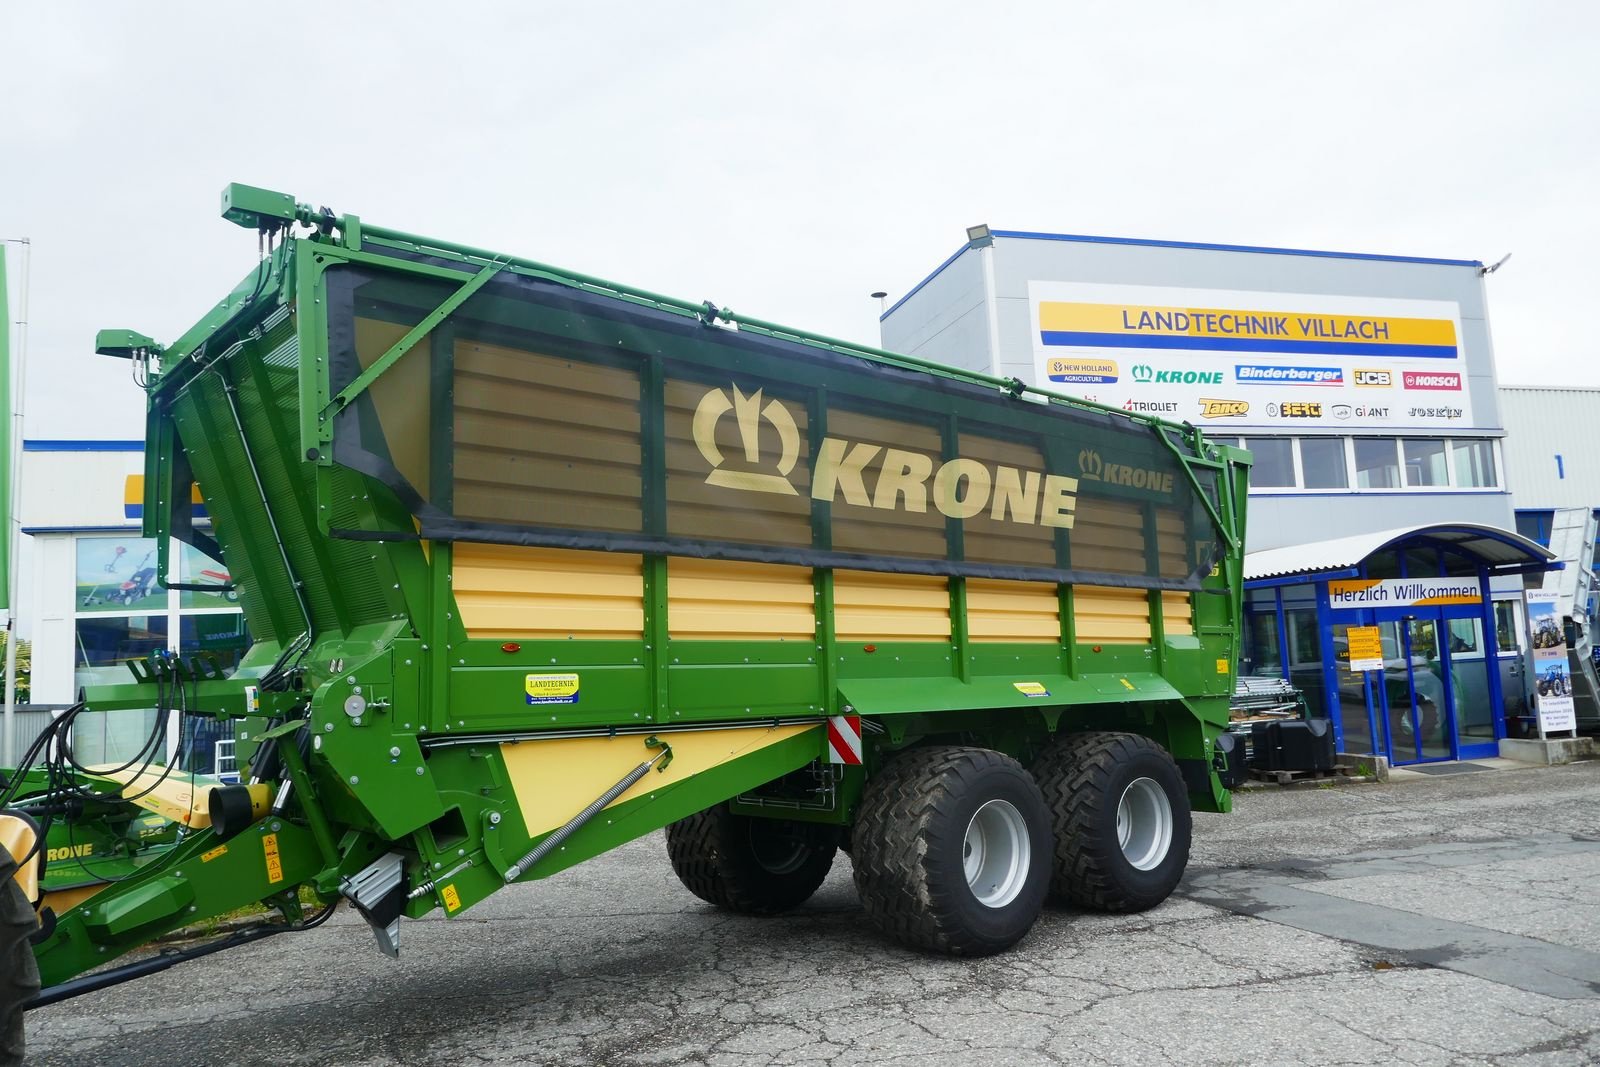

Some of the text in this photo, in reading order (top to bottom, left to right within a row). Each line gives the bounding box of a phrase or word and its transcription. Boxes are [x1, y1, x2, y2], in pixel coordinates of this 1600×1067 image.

[1122, 309, 1389, 340] LANDTECHNIK VILLACH
[1064, 364, 1113, 373] NEW HOLLAND
[1238, 367, 1341, 382] Binderberger
[1064, 375, 1103, 383] AGRICULTURE
[1155, 370, 1223, 385] KRONE
[1355, 372, 1391, 385] JCB
[1415, 376, 1458, 387] HORSCH
[1133, 402, 1178, 412] TRIOLIET
[1199, 398, 1249, 418] Tanco
[811, 437, 1078, 528] KRONE
[1104, 465, 1173, 493] KRONE
[1334, 583, 1477, 602] Herzlich Willkommen
[47, 843, 93, 862] RONE
